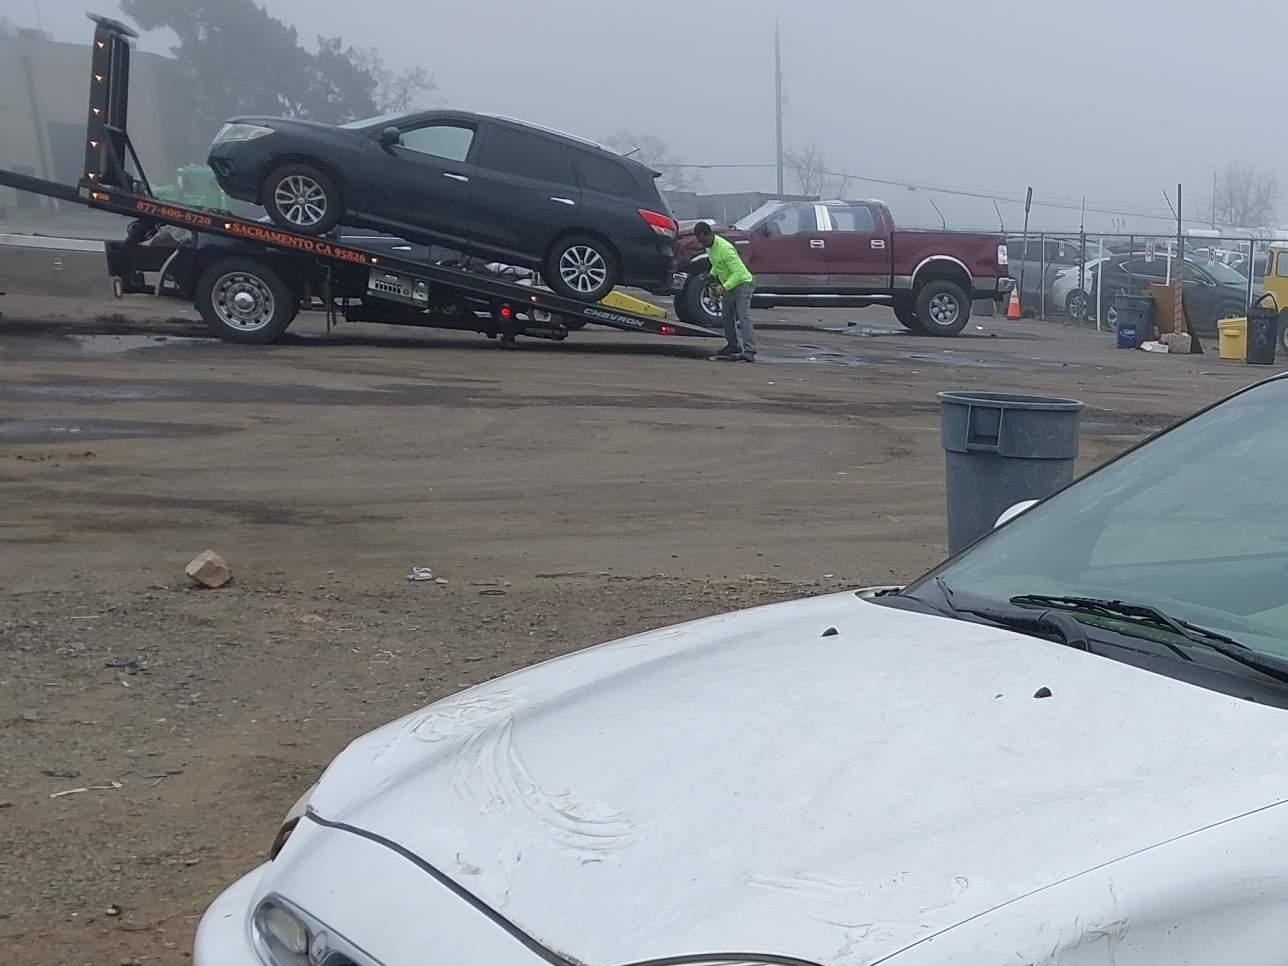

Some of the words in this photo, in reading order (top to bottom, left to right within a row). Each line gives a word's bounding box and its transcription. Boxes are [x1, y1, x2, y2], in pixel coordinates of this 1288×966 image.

[135, 200, 213, 225] 877-600-8720
[232, 222, 314, 250] SACRAMENTO
[315, 243, 332, 256] CA
[333, 247, 366, 264] 95826
[583, 307, 645, 327] CHEVRON
